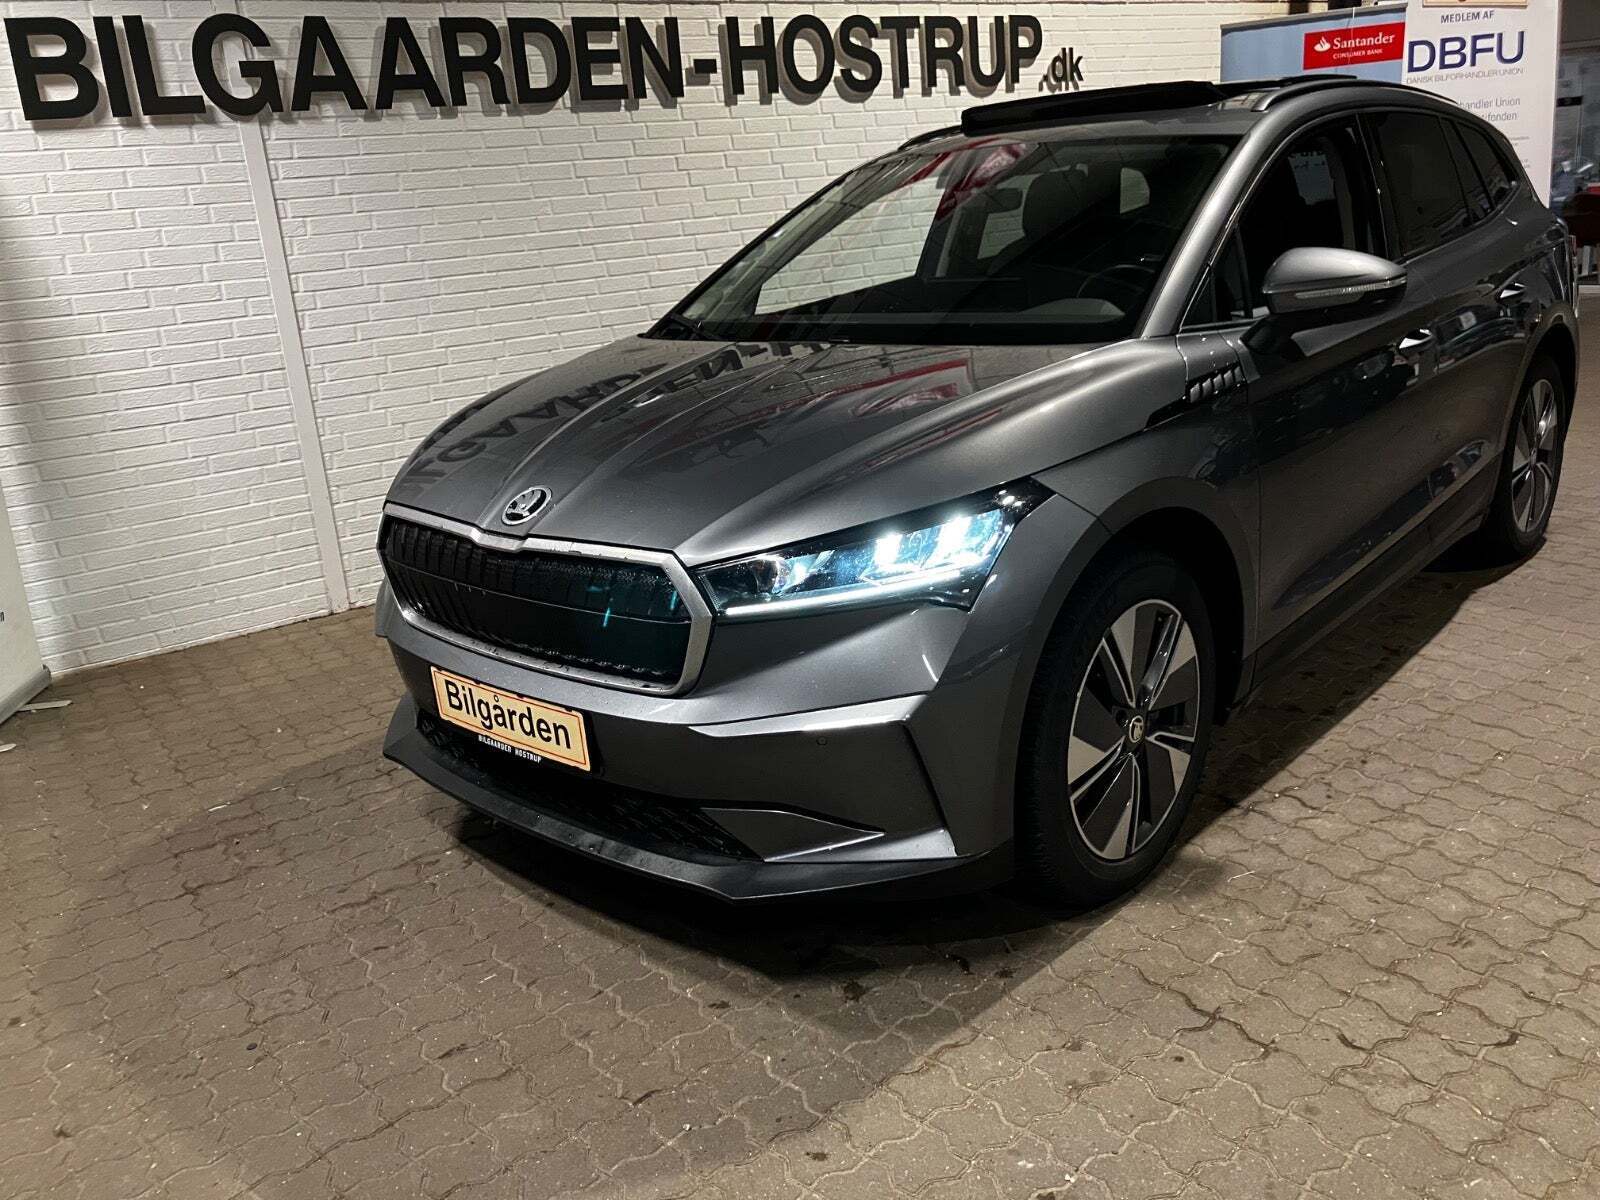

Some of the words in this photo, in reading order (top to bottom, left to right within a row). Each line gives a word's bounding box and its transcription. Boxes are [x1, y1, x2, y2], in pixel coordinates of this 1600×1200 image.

[1441, 12, 1480, 23] MEDLEM
[1483, 10, 1495, 19] AF
[1333, 32, 1395, 50] Santander
[1333, 50, 1366, 60] CONSUMER
[1367, 48, 1383, 56] BANK
[1408, 31, 1525, 73] DBFU
[1406, 75, 1434, 84] DANSK
[1499, 67, 1524, 77] UNION
[1495, 97, 1521, 107] Union
[444, 679, 571, 750] Bilgården
[514, 747, 542, 763] HOSTRUP
